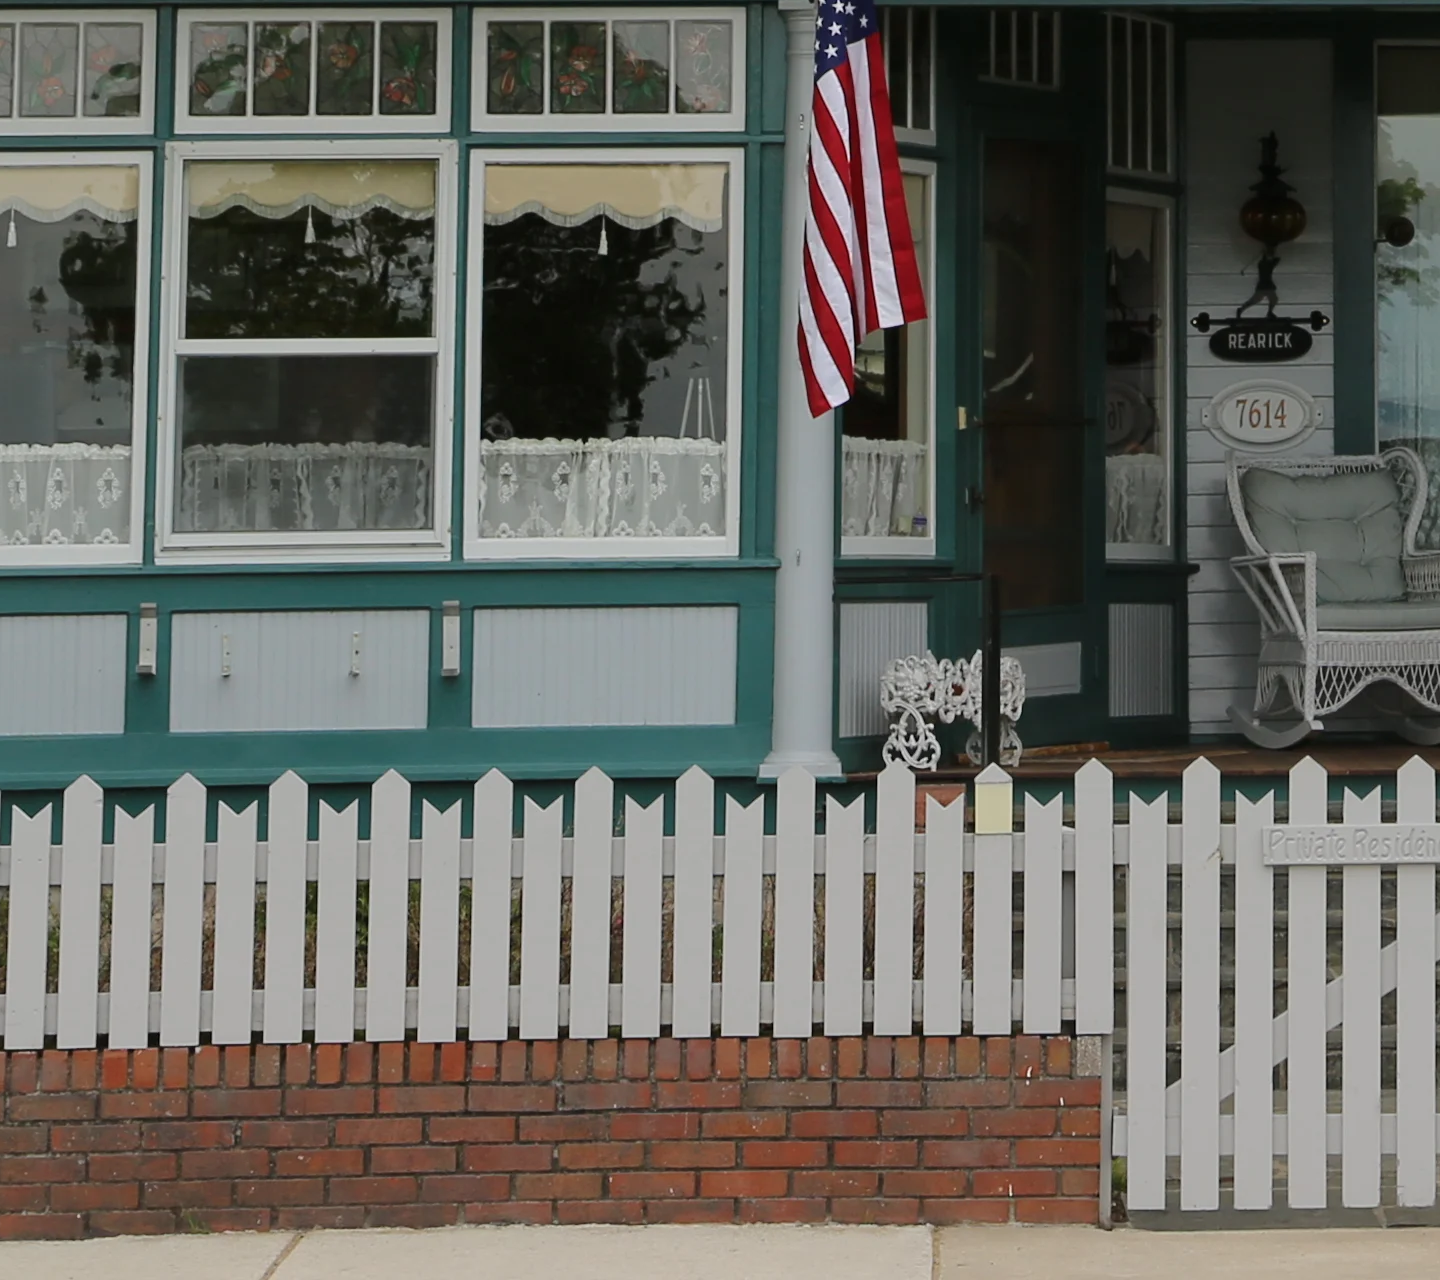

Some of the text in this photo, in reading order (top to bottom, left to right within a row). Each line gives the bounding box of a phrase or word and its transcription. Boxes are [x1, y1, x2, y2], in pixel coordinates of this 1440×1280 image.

[1228, 332, 1293, 349] REARICK
[1235, 398, 1287, 429] 7614
[1268, 828, 1346, 860] Private
